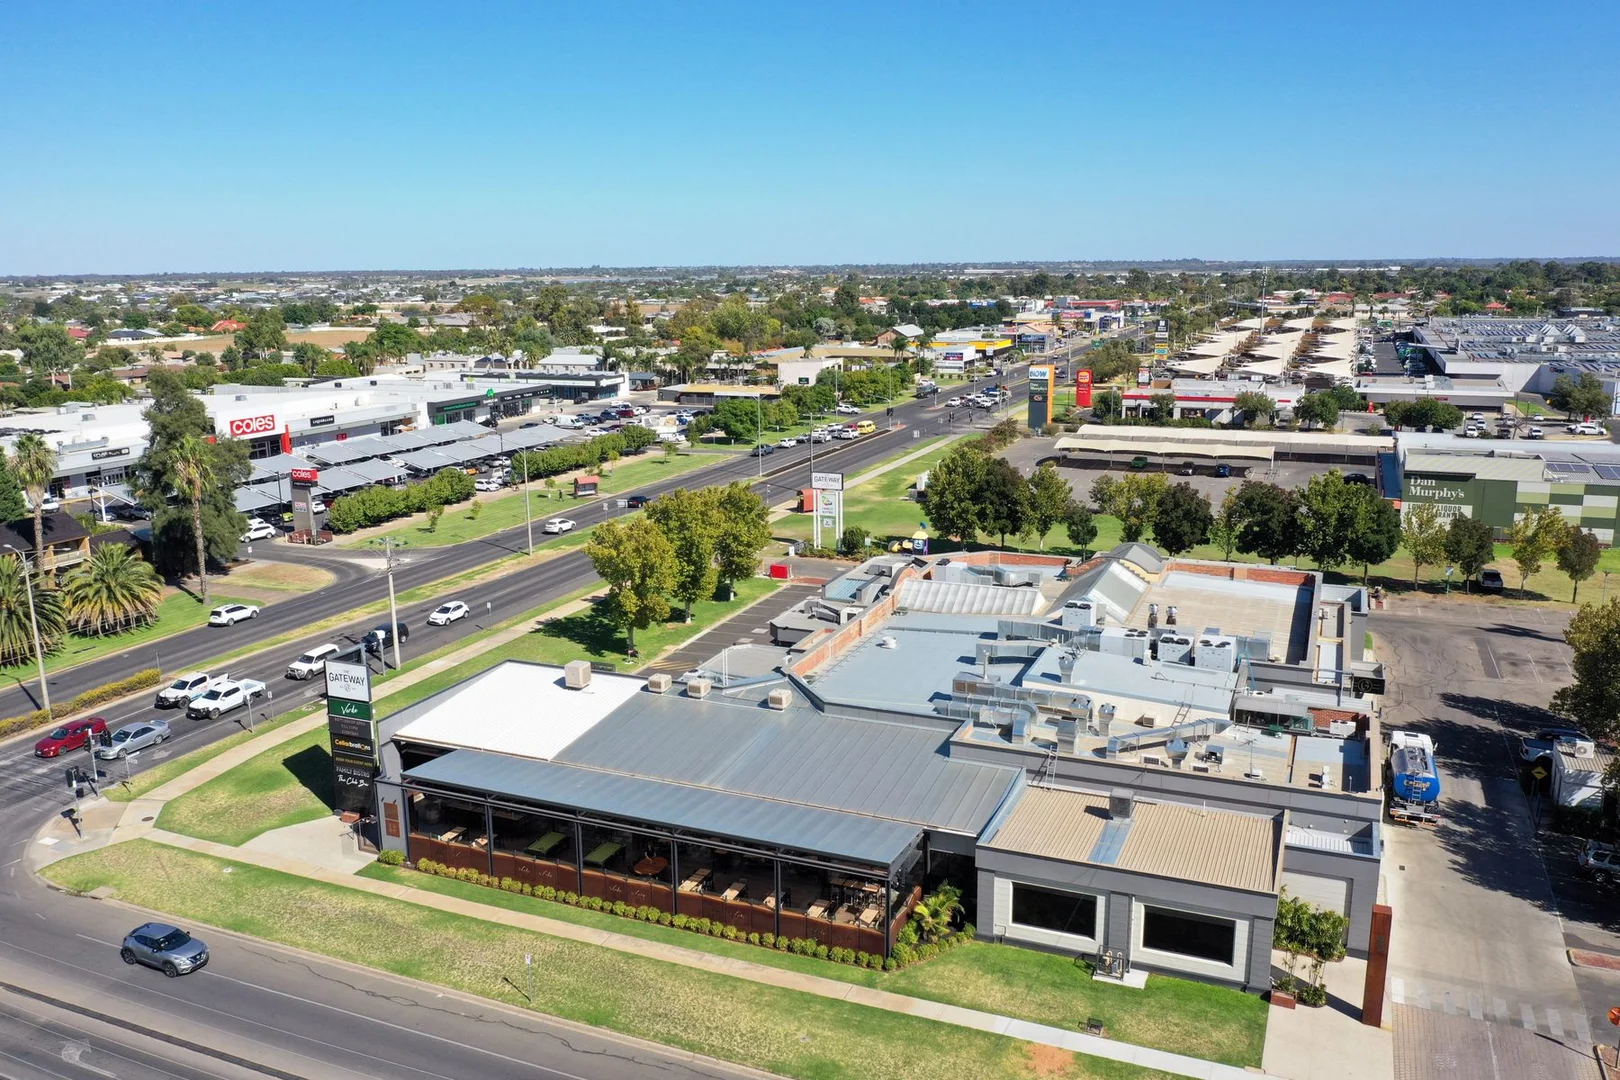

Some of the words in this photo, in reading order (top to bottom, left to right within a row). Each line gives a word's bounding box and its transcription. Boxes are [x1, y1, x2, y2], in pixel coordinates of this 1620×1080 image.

[232, 416, 274, 434] coles
[292, 470, 311, 479] coles
[1410, 475, 1436, 486] Dan
[1409, 486, 1465, 500] Murphy's
[1437, 505, 1462, 513] LIQUOR
[329, 672, 365, 686] GATEWAY
